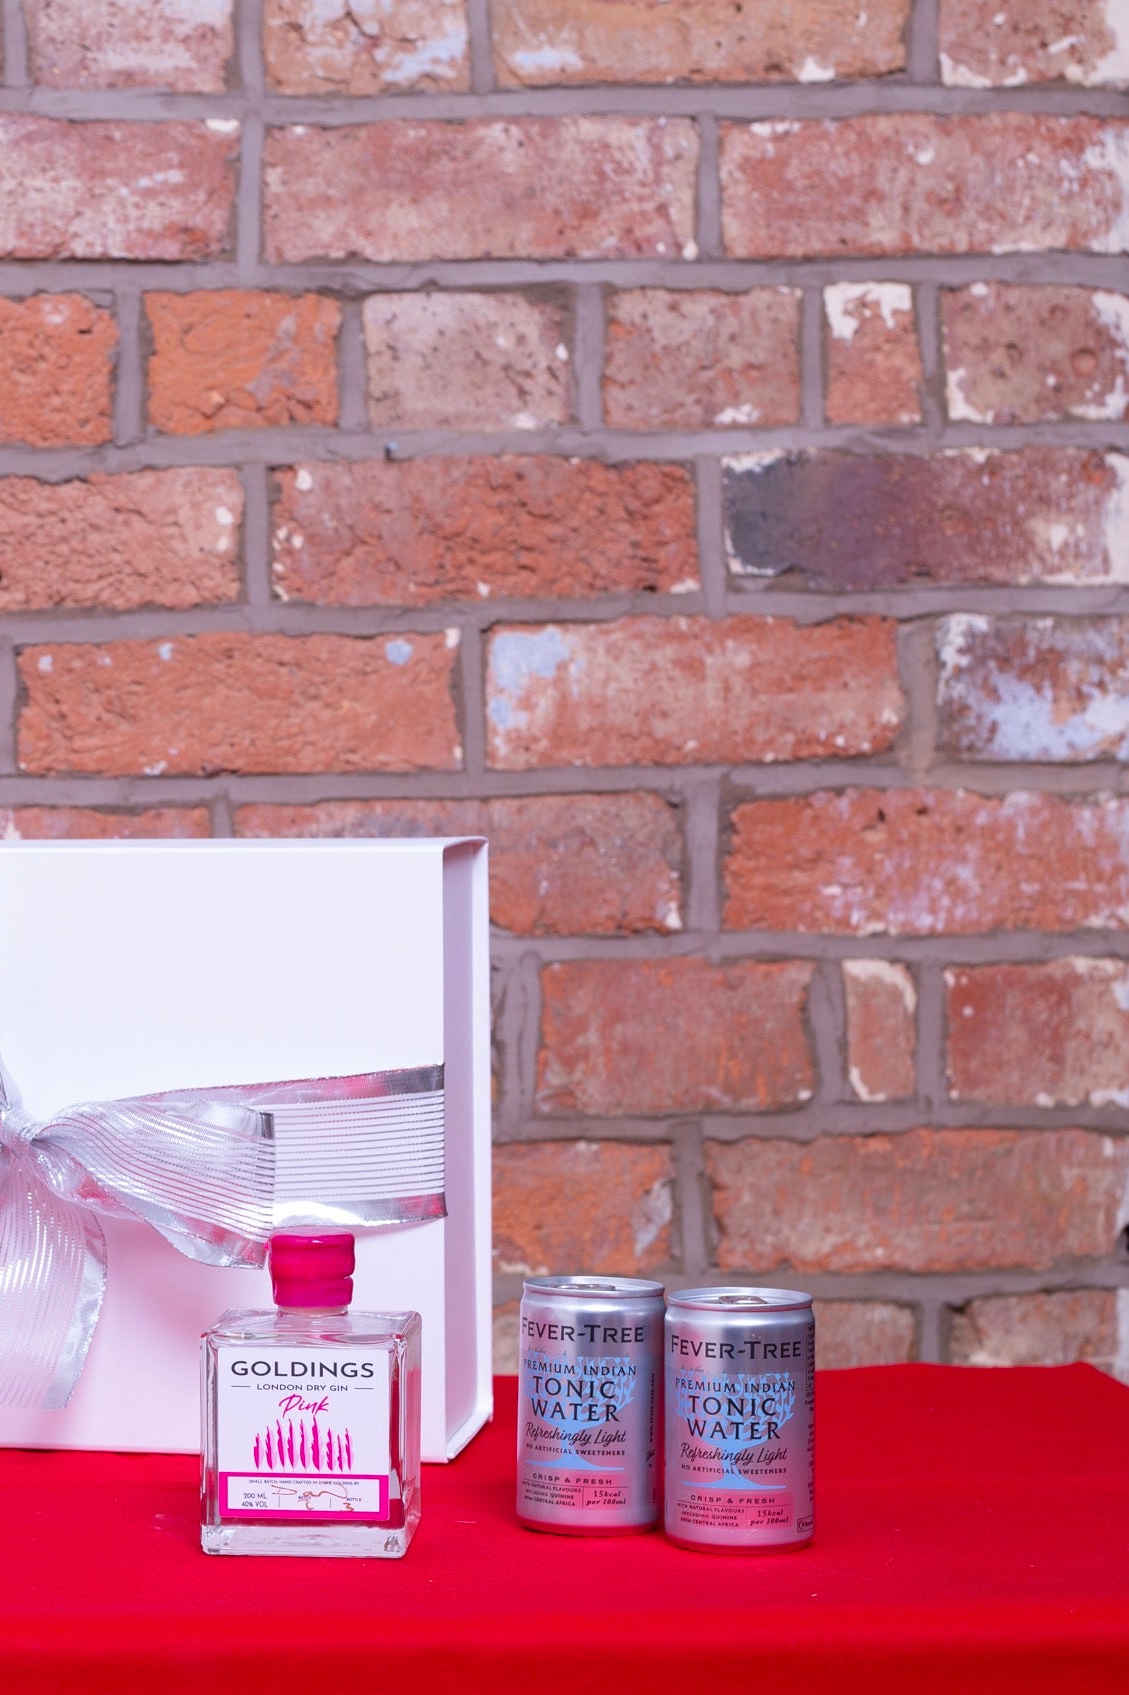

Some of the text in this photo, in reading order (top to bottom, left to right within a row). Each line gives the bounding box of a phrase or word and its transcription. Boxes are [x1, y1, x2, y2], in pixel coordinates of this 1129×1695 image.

[231, 1361, 374, 1378] GOLDINGS
[524, 1358, 636, 1375] PREMIUM INDIAN
[306, 1384, 326, 1392] DRY
[533, 1376, 615, 1399] TONIC
[675, 1378, 795, 1393] PREMIUM INDIAN
[278, 1394, 329, 1418] Pink
[531, 1398, 620, 1422] WATER
[689, 1395, 776, 1417] TONIC
[526, 1422, 627, 1447] Refreshingly Light
[687, 1418, 781, 1440] WATER
[535, 1445, 572, 1454] ARTIFICIAL
[680, 1442, 788, 1466] Refreshingly Light
[533, 1473, 560, 1482] CRISP
[693, 1465, 734, 1474] ARTIFICIAL
[691, 1494, 722, 1503] CRISP
[758, 1509, 784, 1517] 15kcal
